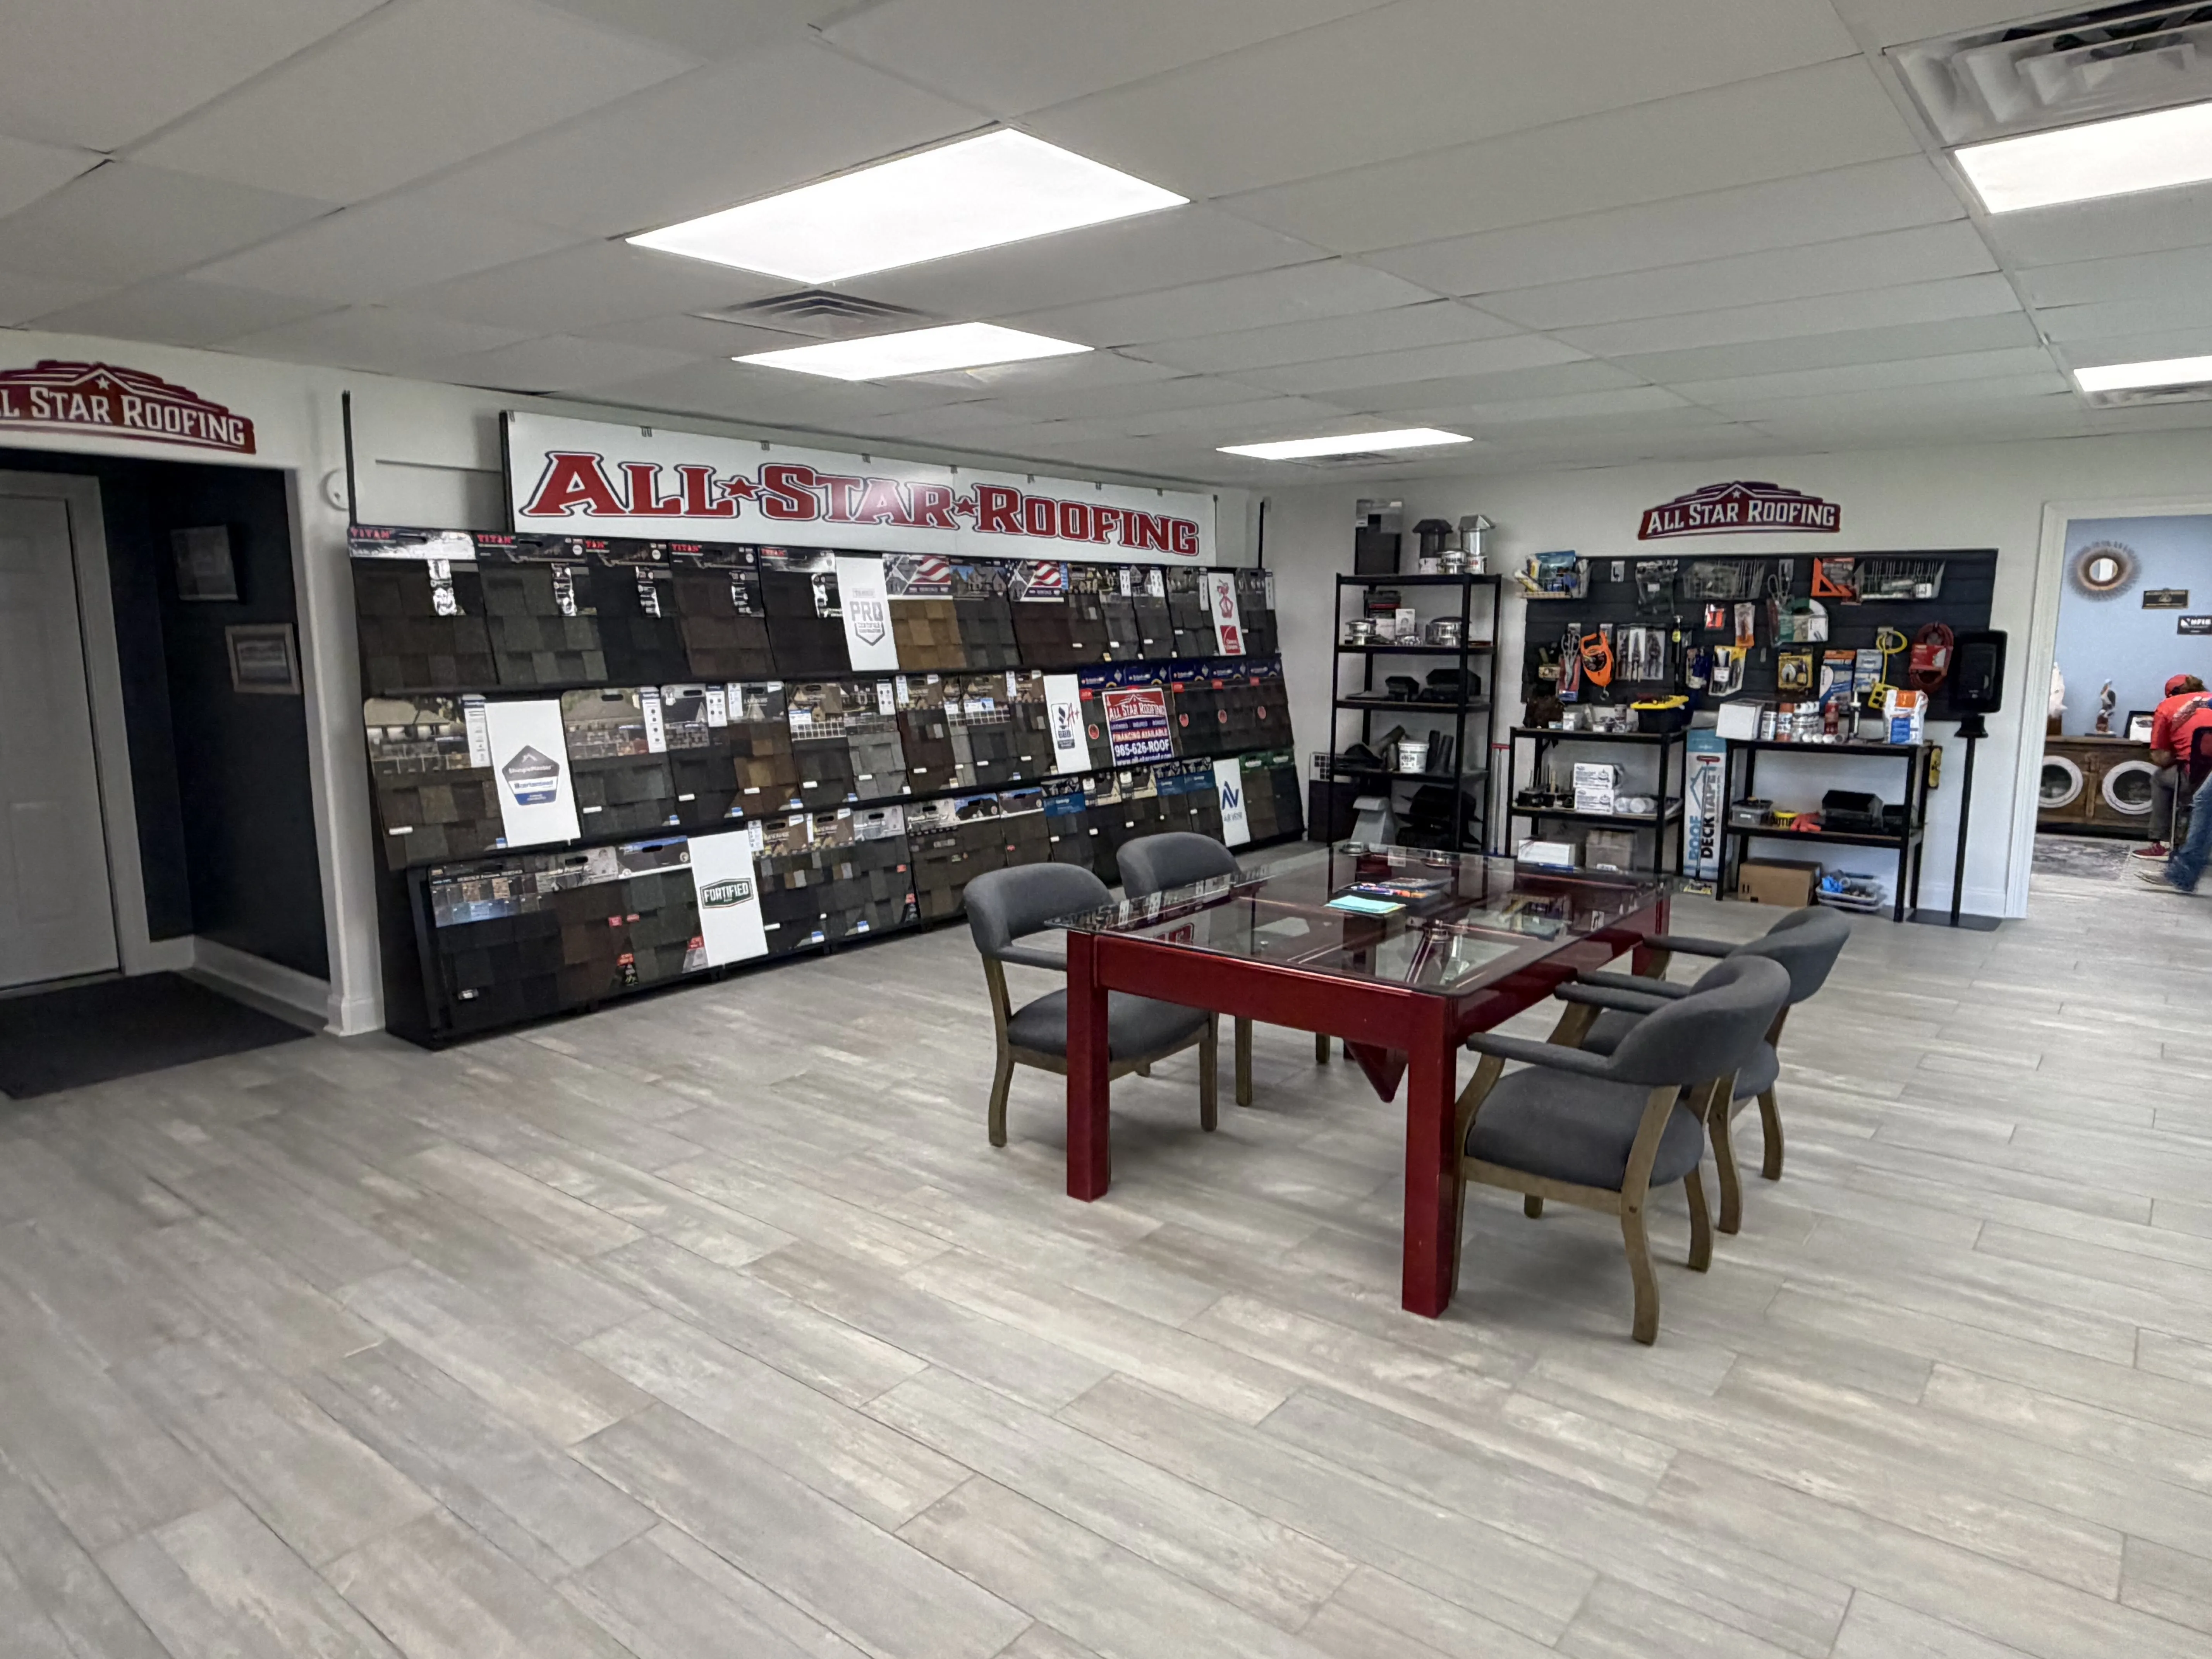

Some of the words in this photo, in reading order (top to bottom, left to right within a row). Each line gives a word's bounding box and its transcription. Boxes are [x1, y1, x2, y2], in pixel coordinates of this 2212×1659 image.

[0, 388, 20, 417] L
[30, 387, 112, 423] STAR
[121, 395, 245, 445] ROOFING
[519, 452, 740, 519] ALL
[761, 463, 959, 530] STAR
[971, 483, 1199, 556] ROOFING
[1646, 510, 1684, 534] ALL
[1689, 503, 1738, 526] STAR
[1747, 500, 1835, 526] ROOFING
[476, 534, 512, 545] TITAN
[850, 601, 883, 621] PRO
[1109, 707, 1121, 721] ALL
[1121, 703, 1138, 717] STAR
[1138, 702, 1166, 715] ROOFING
[1115, 739, 1170, 757] 985-626-ROOF
[704, 882, 749, 903] FORTIFIED
